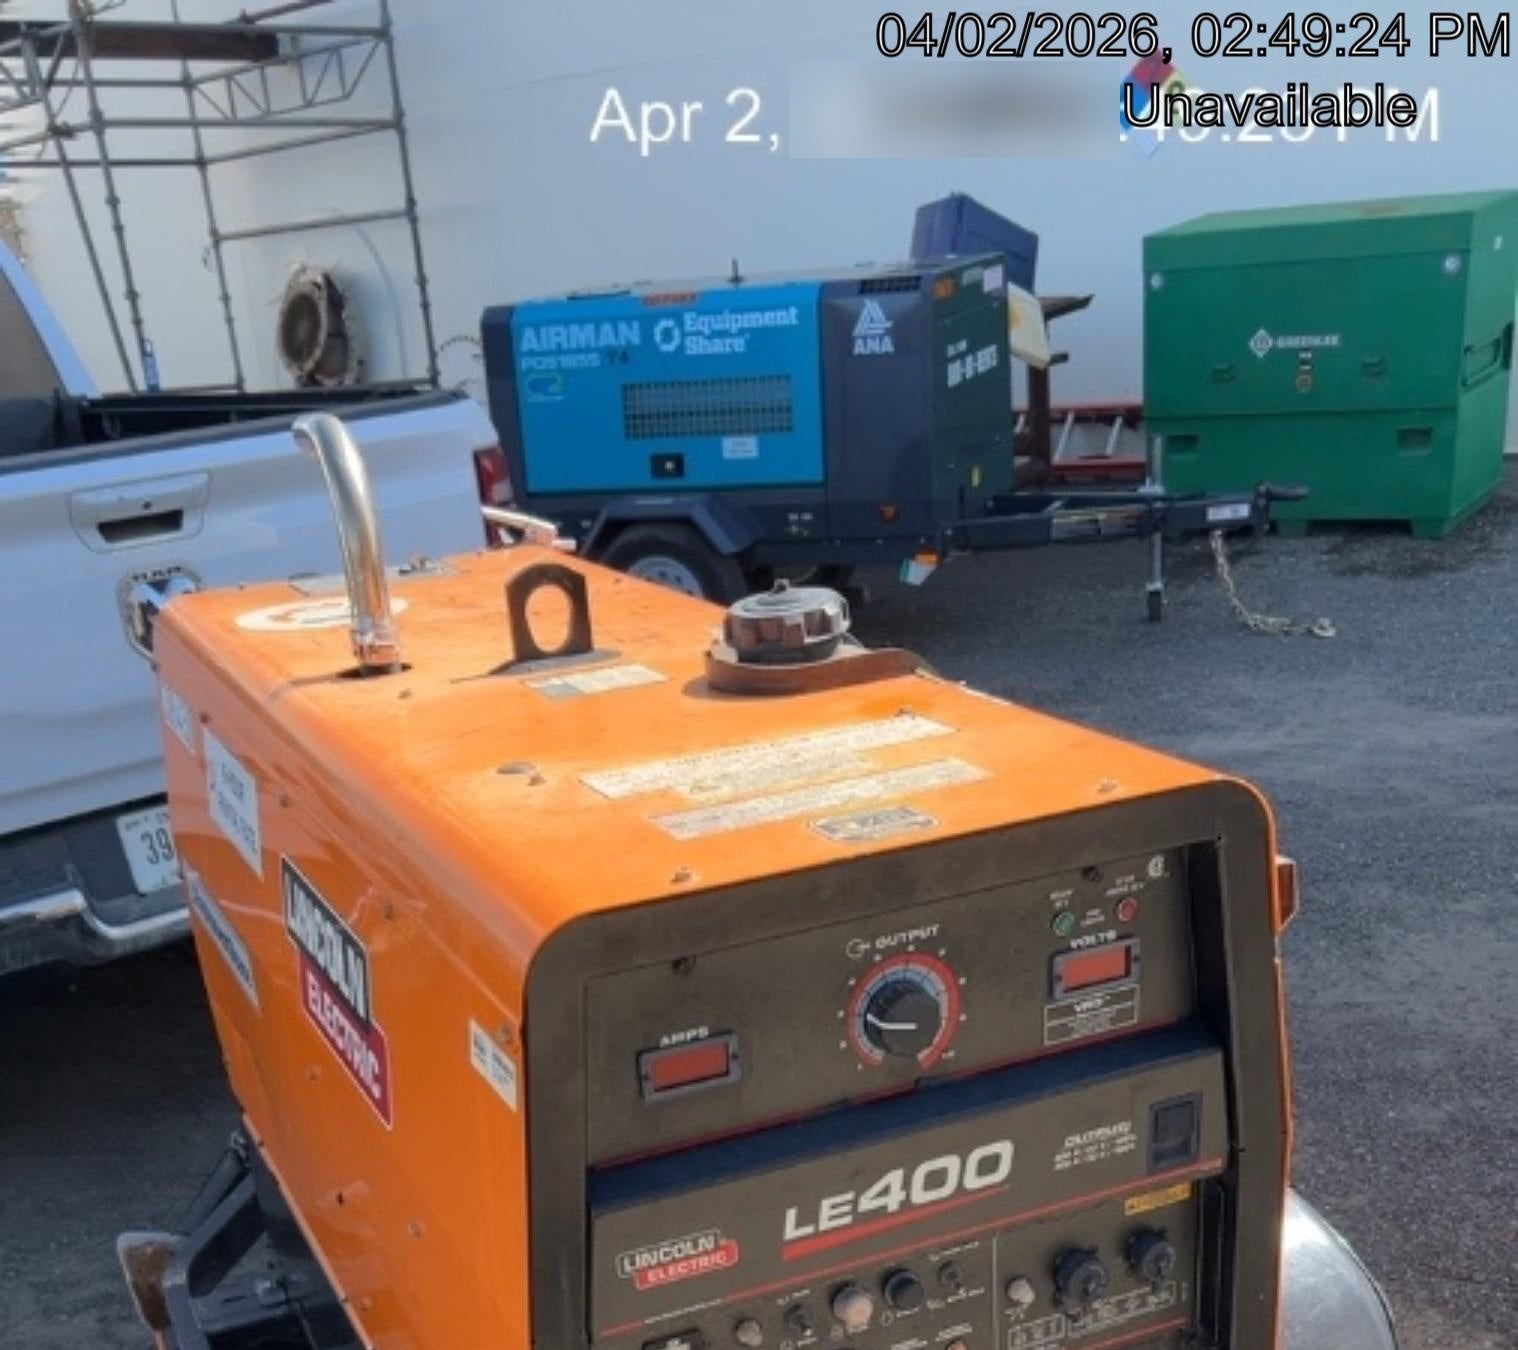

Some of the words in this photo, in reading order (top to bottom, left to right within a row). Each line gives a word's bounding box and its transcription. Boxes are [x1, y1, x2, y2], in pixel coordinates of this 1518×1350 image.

[683, 306, 799, 333] Equipment
[521, 320, 642, 352] AIRMAN
[685, 334, 746, 355] Share
[853, 335, 895, 355] ANA
[284, 871, 367, 1022] LINCOLN
[875, 923, 940, 949] OUTPUT
[305, 967, 382, 1100] ELECTRIC
[659, 1026, 709, 1048] AMPS
[783, 1139, 1015, 1241] LE400
[622, 1233, 716, 1272] LINCOLN
[646, 1249, 728, 1280] ELECTRIC
